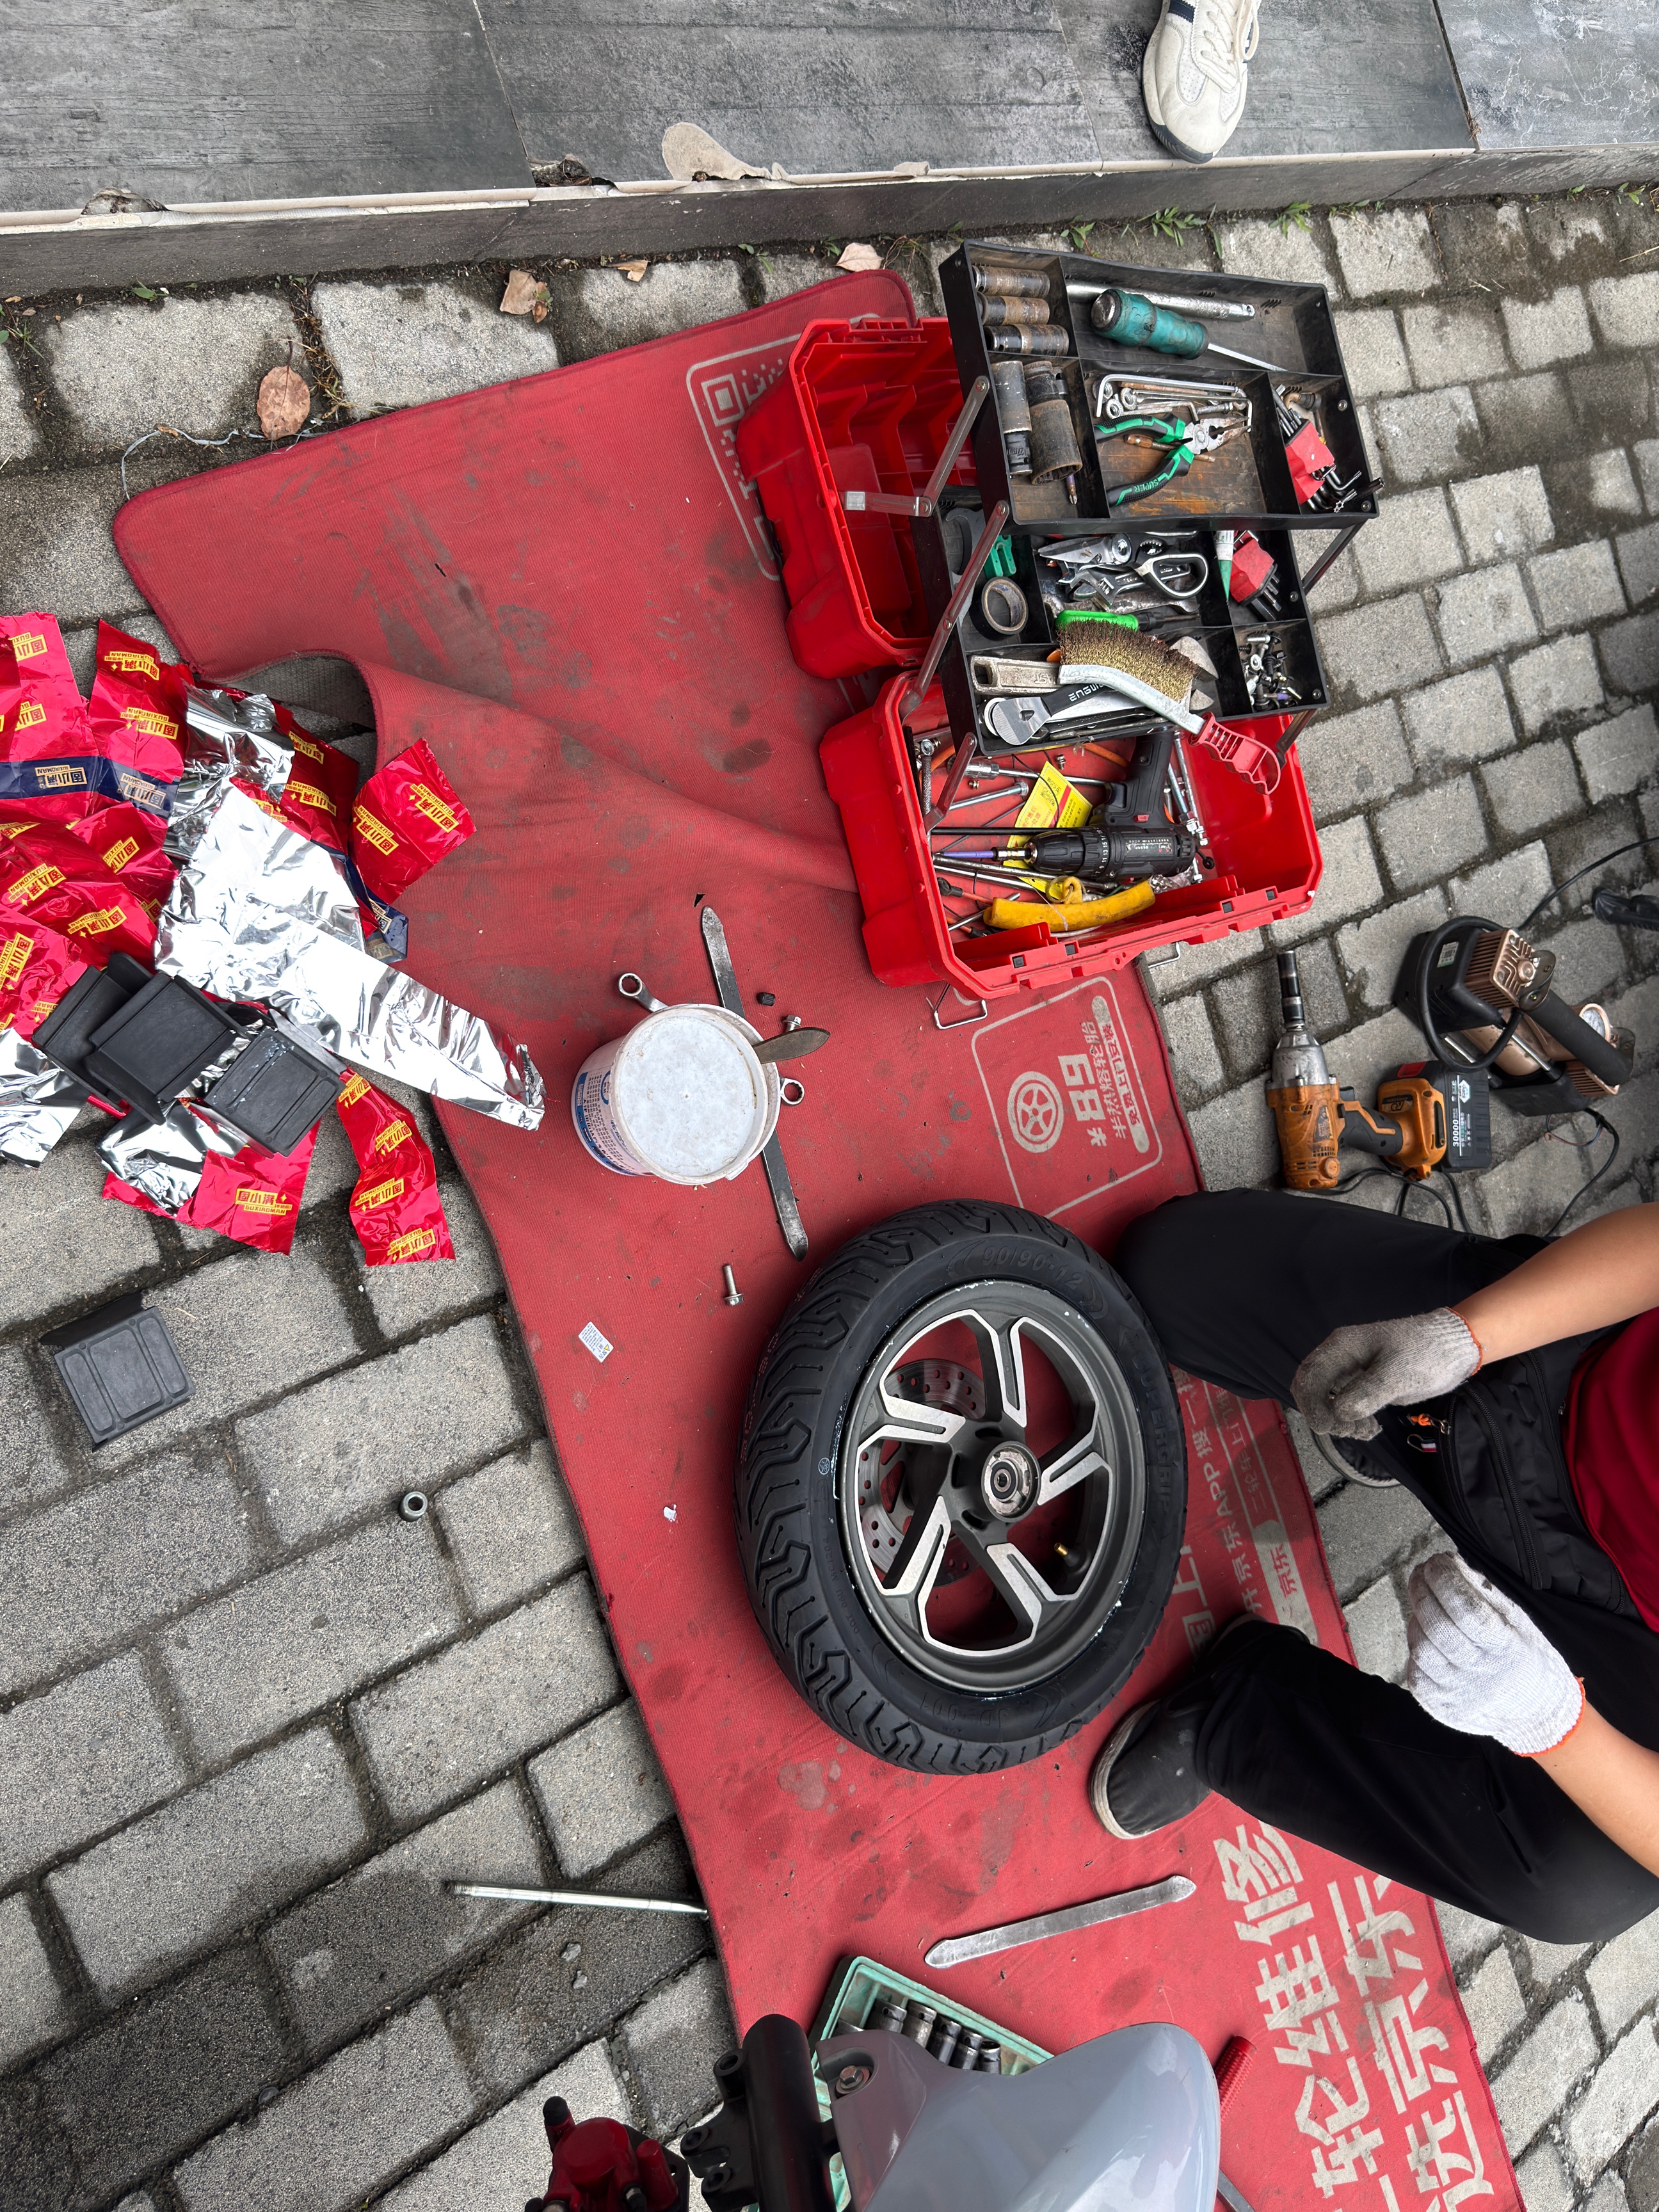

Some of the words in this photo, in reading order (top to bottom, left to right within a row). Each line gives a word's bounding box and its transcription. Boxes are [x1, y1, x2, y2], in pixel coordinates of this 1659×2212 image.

[1134, 479, 1159, 493] SUPER
[124, 659, 158, 678] 固小满
[138, 719, 177, 738] 固小满
[47, 771, 85, 786] 固小满
[127, 783, 164, 806] 固小满
[419, 785, 453, 815] GUXIAOMAN
[359, 806, 392, 837] GUXIAOMAN
[419, 799, 455, 830] 固小满
[358, 821, 395, 853] 固小满
[10, 865, 47, 893] GUXIAOMAN
[28, 869, 63, 897] 固小满
[88, 908, 125, 932] 固小满
[6, 937, 31, 979] 固小满
[1081, 1021, 1127, 1140] 半热熔轮胎
[1100, 1024, 1141, 1125] 免费上门安装
[238, 1190, 275, 1205] 固小满
[371, 1182, 402, 1205] 固小满
[245, 1205, 285, 1214] GUXIAOMAN
[982, 1246, 1085, 1290] 90/90-12
[1132, 1352, 1173, 1512] SUPERGRIP
[846, 1614, 862, 1635] DOT
[919, 1692, 1009, 1729] JD-001
